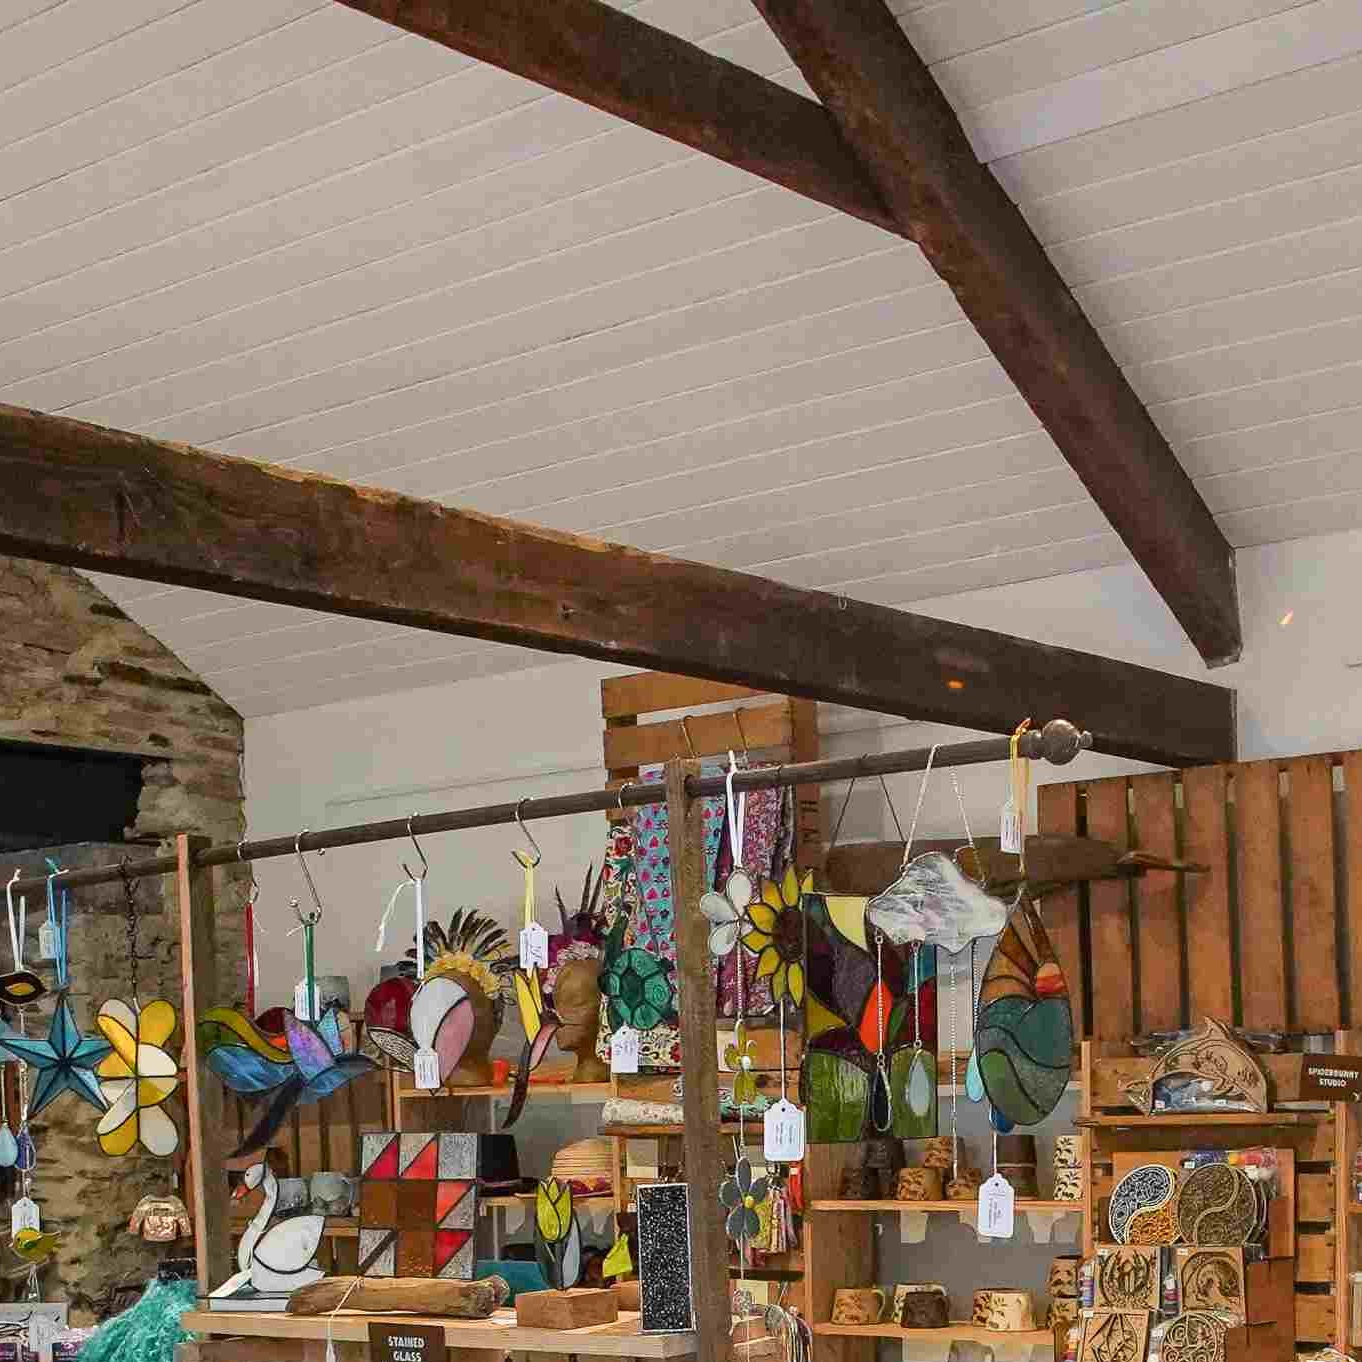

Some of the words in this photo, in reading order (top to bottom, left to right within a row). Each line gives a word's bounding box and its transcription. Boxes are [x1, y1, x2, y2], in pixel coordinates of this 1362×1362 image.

[1319, 1079, 1347, 1088] STUDIO
[388, 1336, 425, 1348] STAINED
[393, 1351, 422, 1362] GLASS
